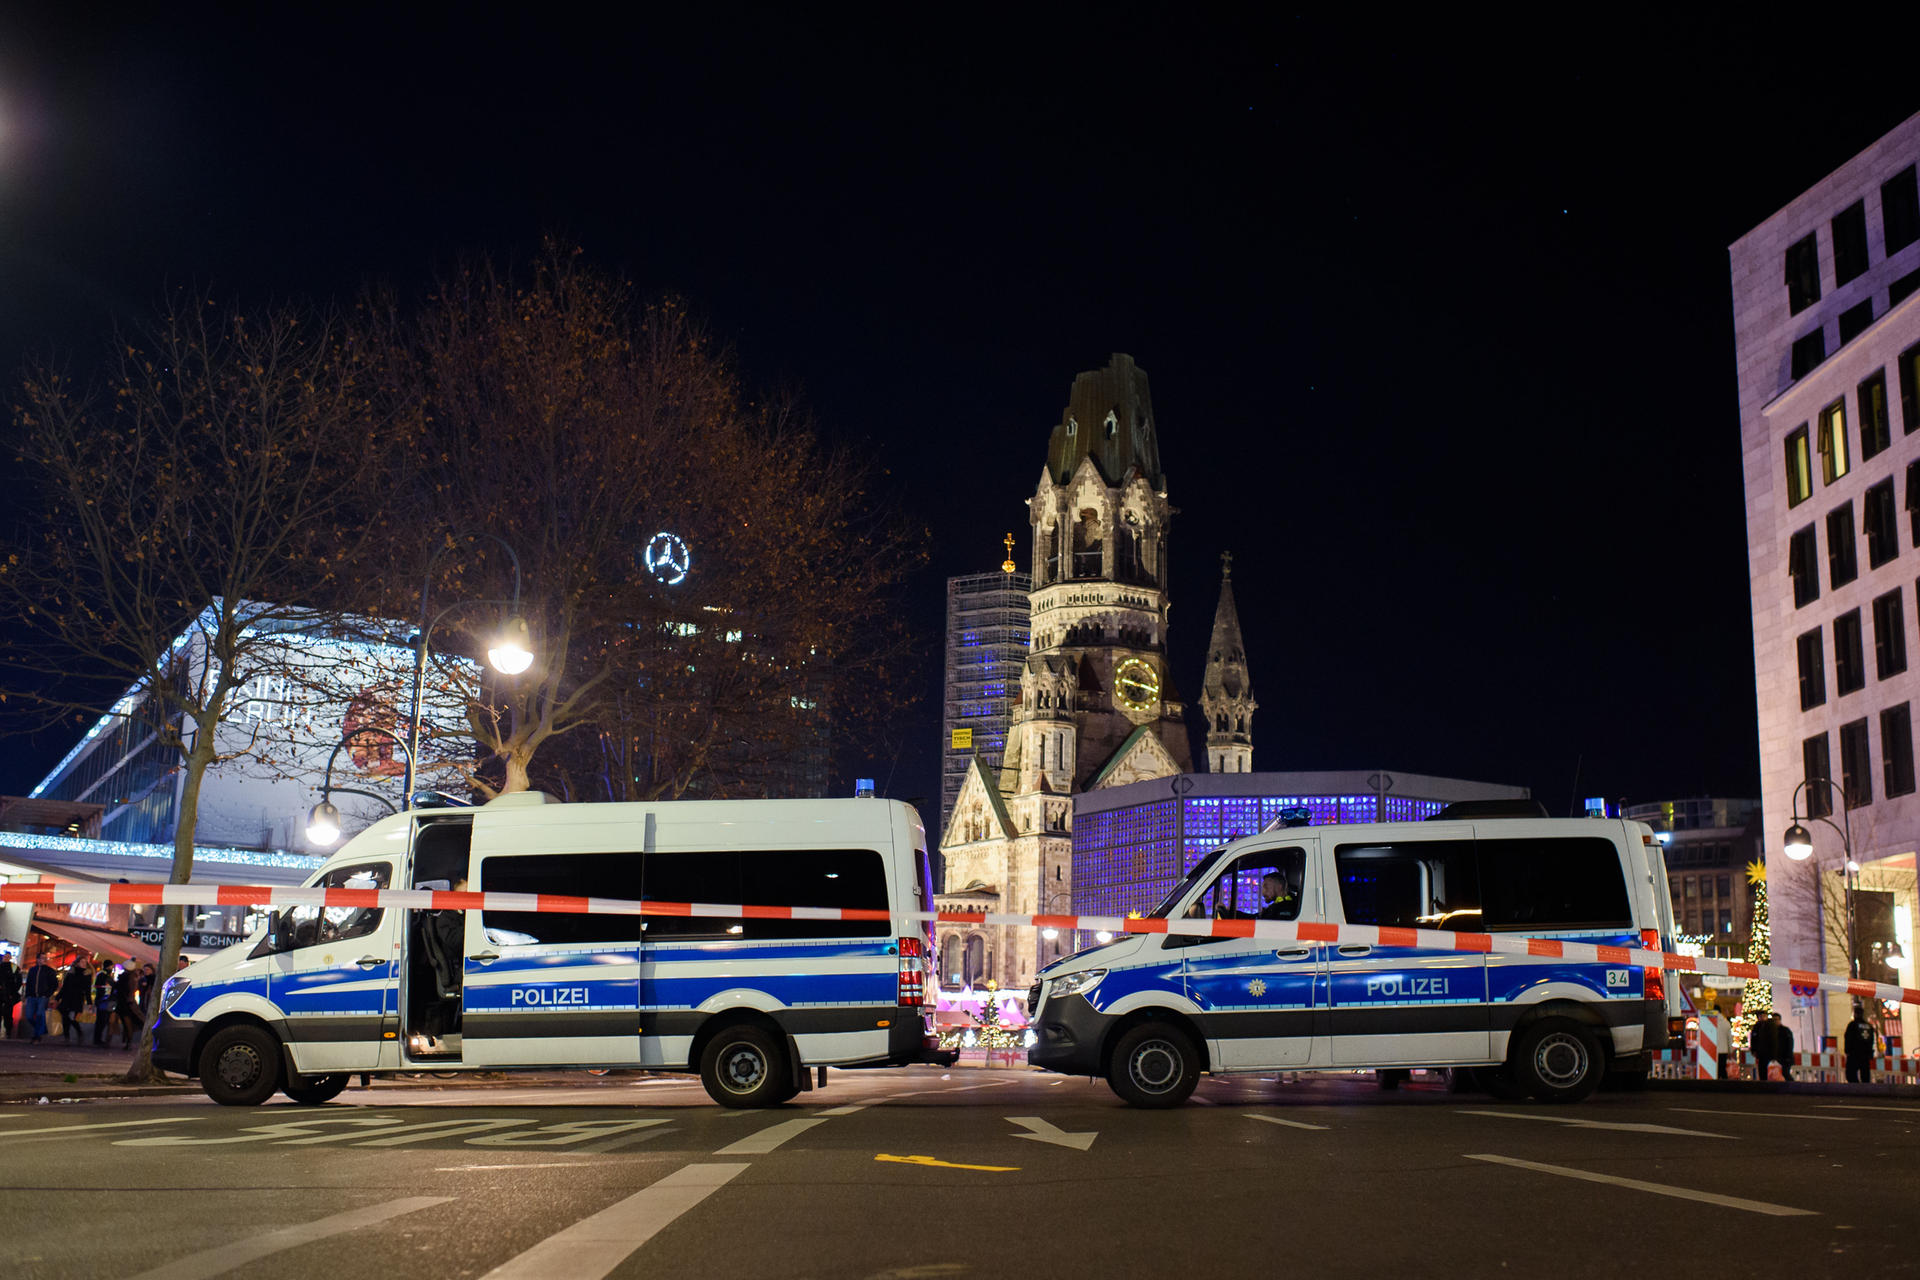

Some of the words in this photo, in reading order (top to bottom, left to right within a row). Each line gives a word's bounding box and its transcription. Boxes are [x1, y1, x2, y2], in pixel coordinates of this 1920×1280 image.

[221, 699, 311, 728] ERLIN
[200, 935, 247, 946] SCHNA
[1367, 978, 1448, 996] POLIZEI
[1608, 971, 1627, 985] 34
[511, 987, 589, 1005] POLIZEI
[111, 1113, 676, 1146] BUS
